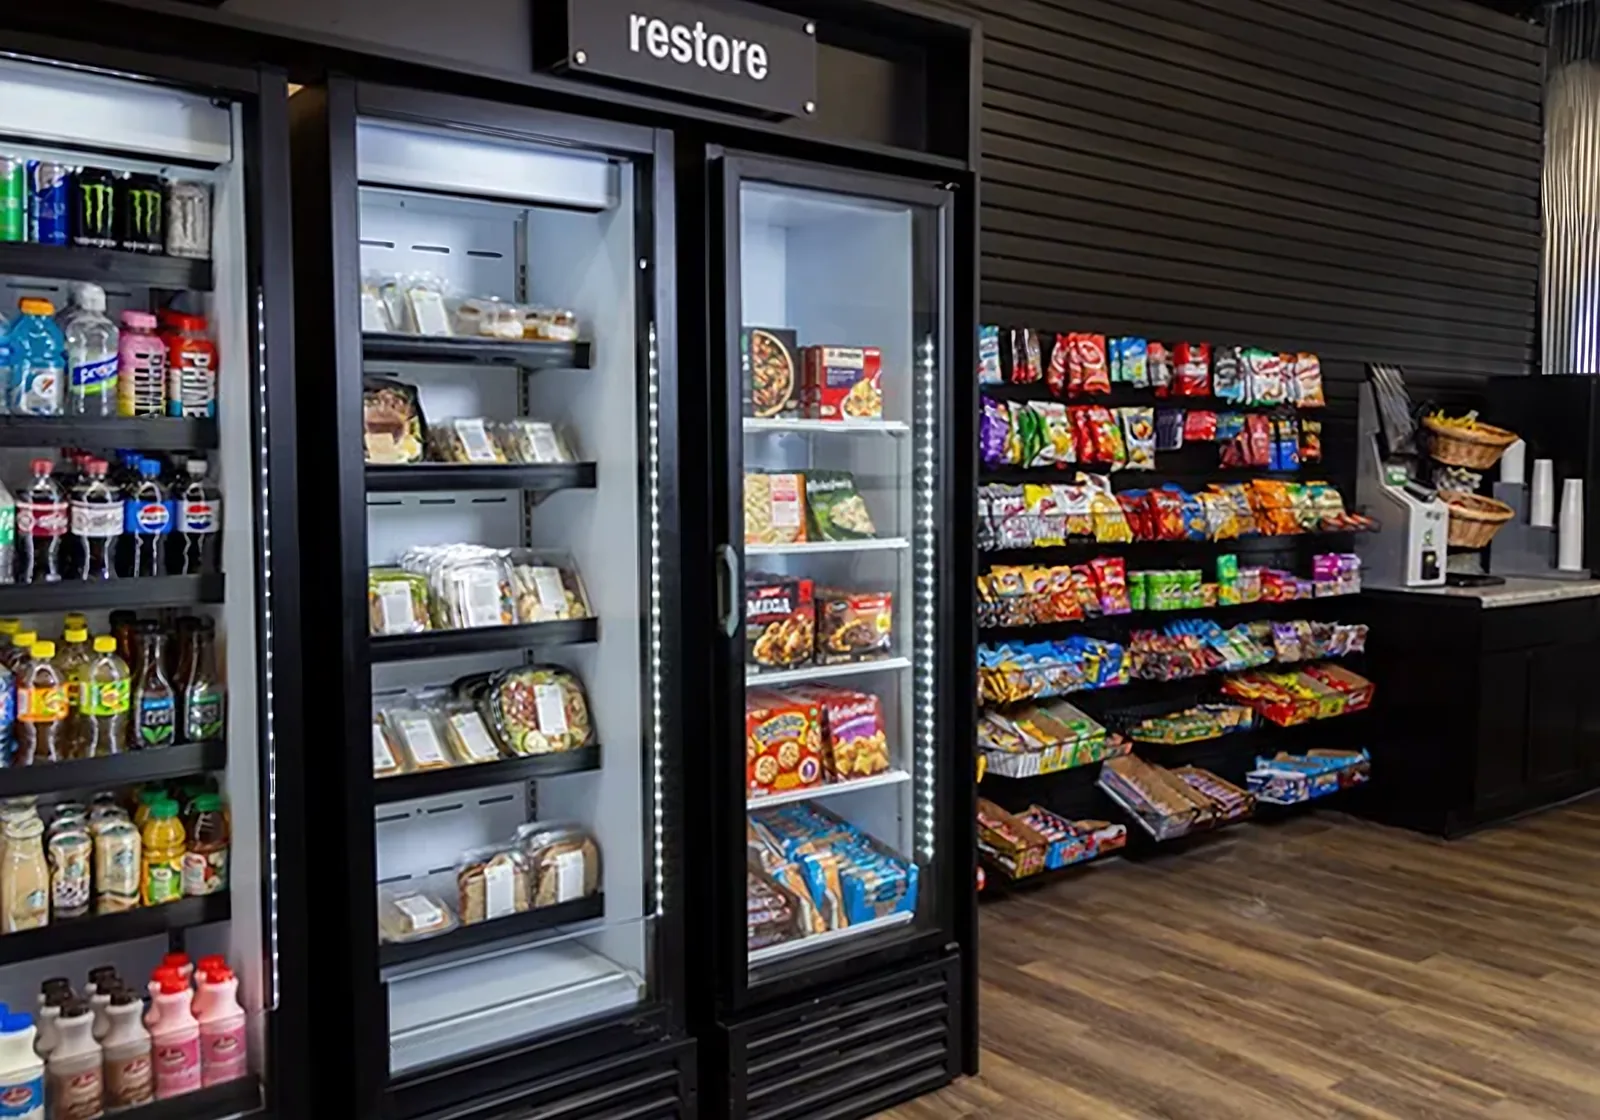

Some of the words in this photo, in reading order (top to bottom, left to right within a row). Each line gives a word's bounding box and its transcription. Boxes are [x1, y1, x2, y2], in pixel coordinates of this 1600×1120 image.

[629, 13, 768, 80] restore
[181, 351, 211, 417] PRIME
[746, 598, 792, 617] MEGA
